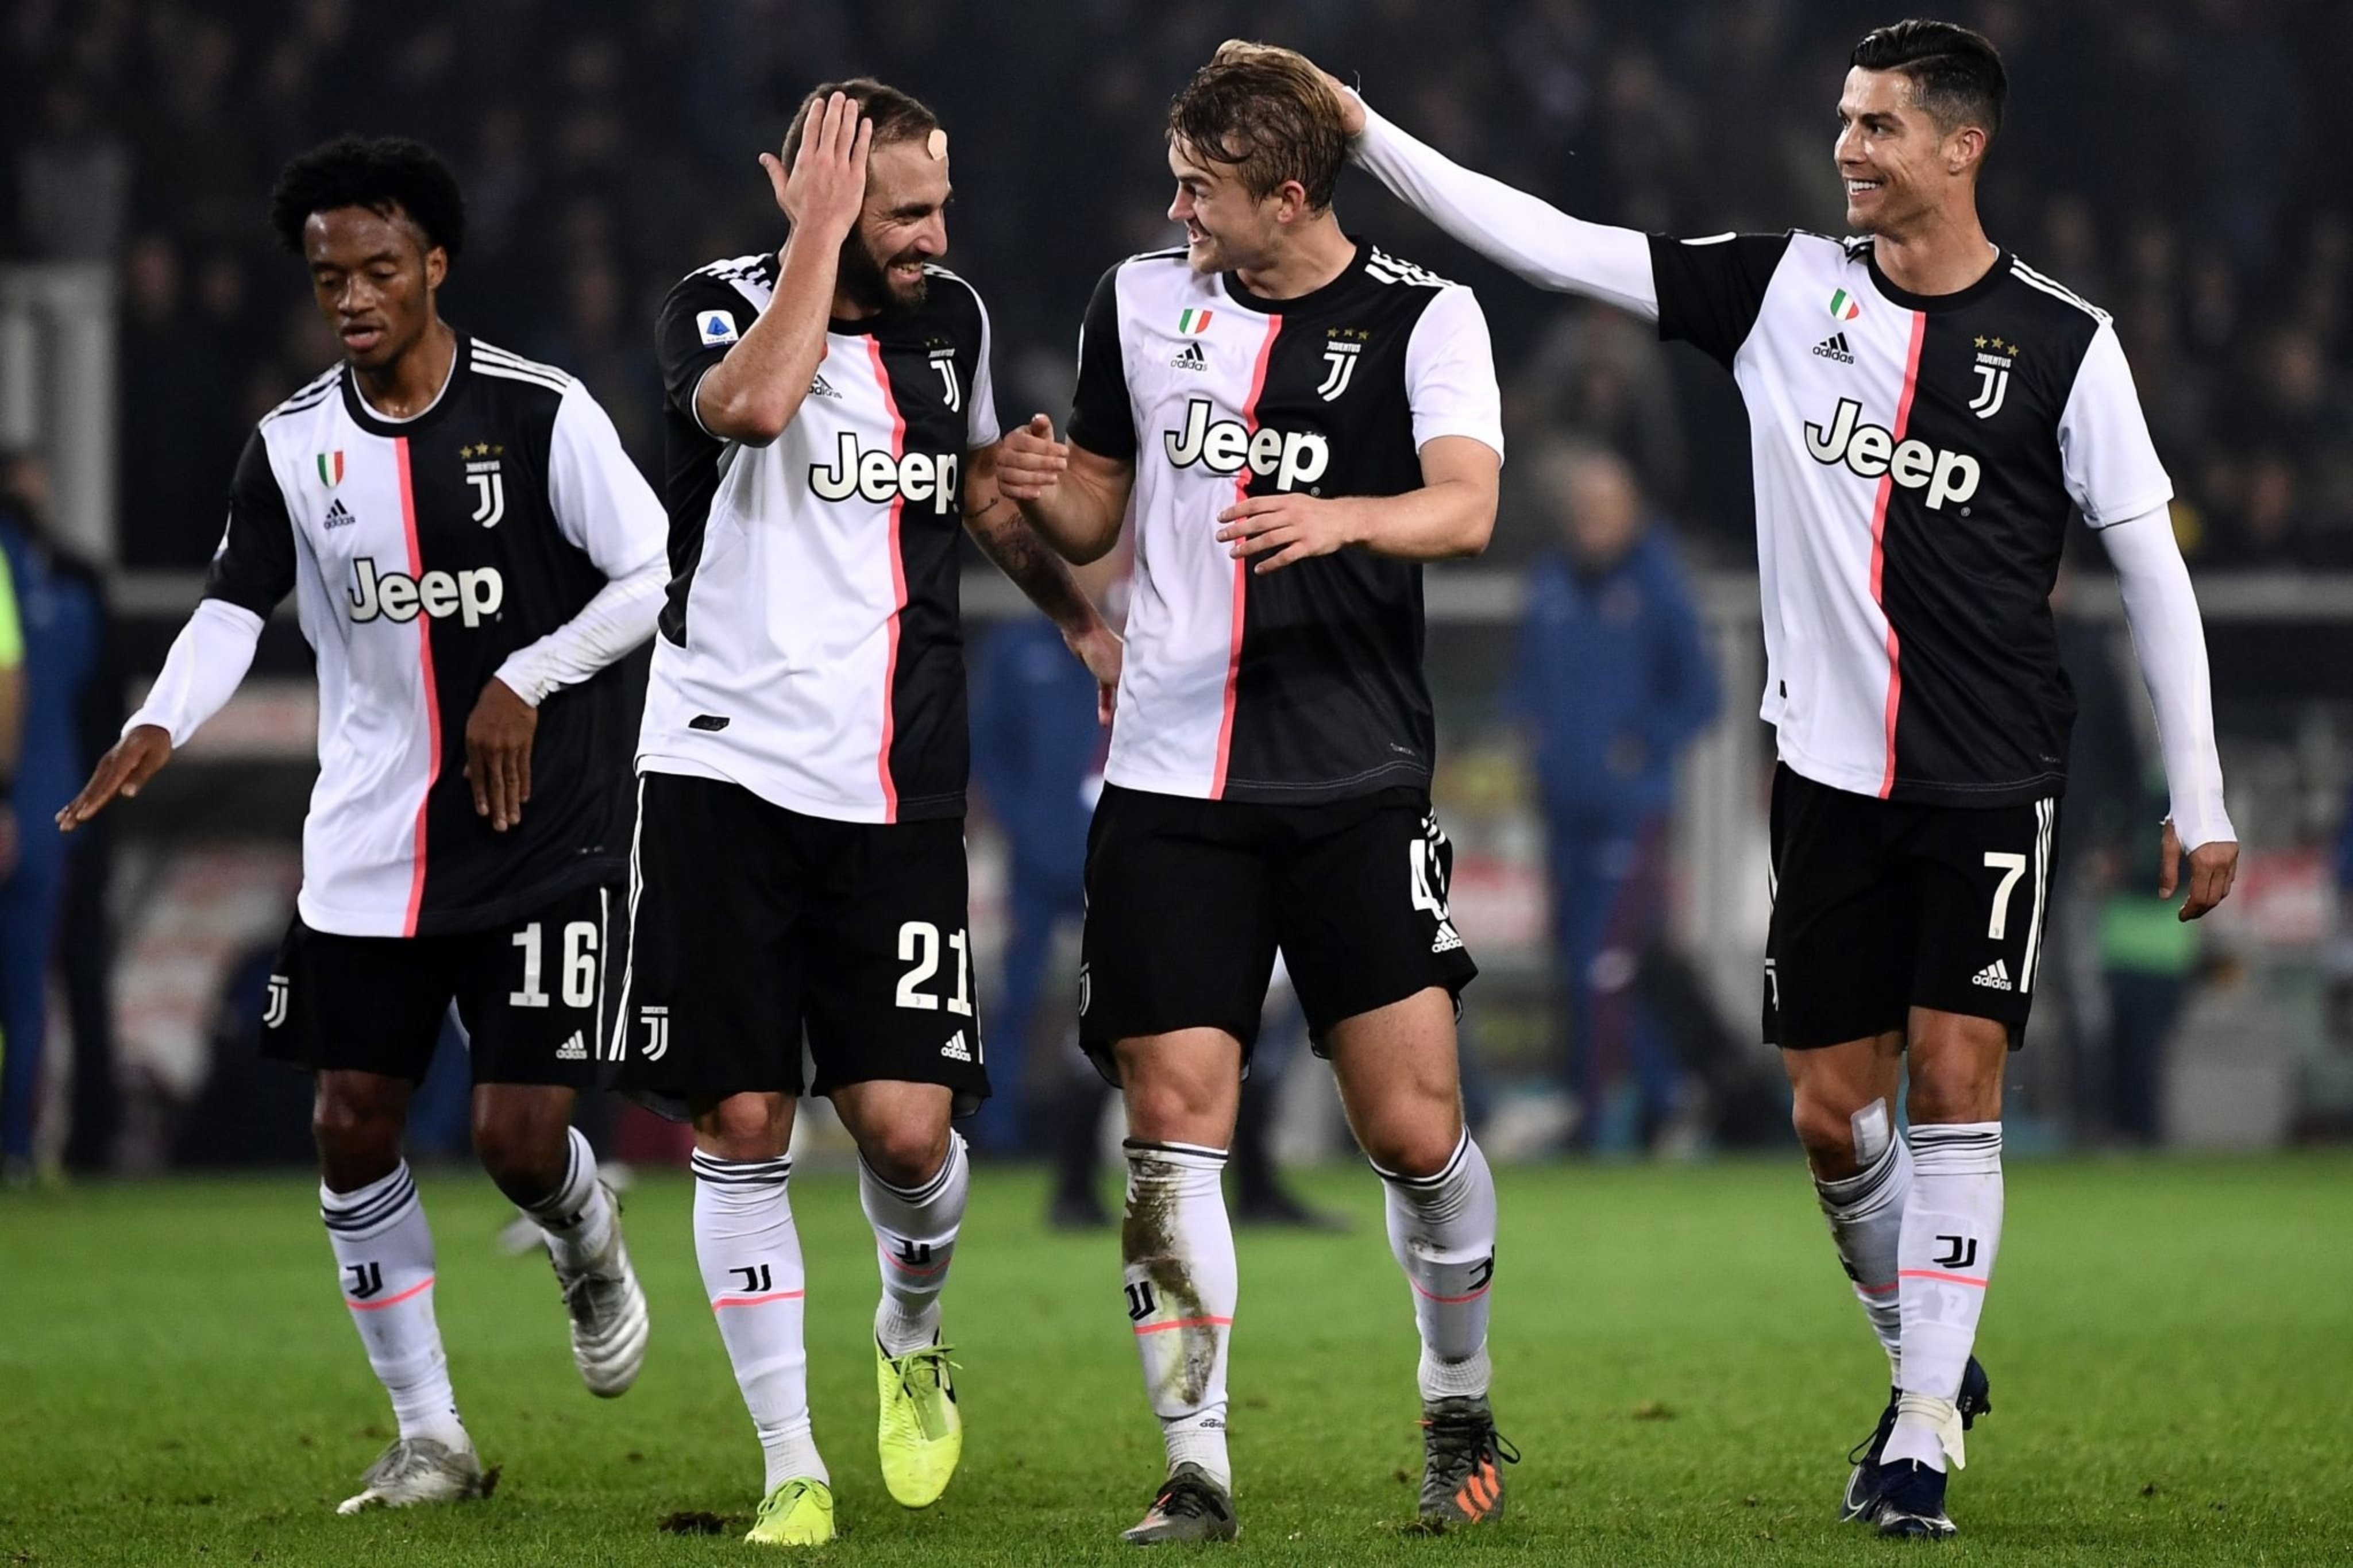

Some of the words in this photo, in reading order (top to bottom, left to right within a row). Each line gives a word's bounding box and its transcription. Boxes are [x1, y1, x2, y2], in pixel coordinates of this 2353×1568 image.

[1812, 346, 1854, 364] adidas
[808, 432, 956, 513] Jeep
[1164, 399, 1329, 491] Jeep
[1804, 397, 1980, 509] Jeep
[348, 557, 503, 627] Jeep
[1410, 839, 1447, 920] 4
[1984, 852, 2026, 940] 7
[510, 921, 597, 1007] 16
[896, 921, 972, 1017] 21
[1432, 939, 1463, 953] adida
[1972, 975, 2012, 991] adidas
